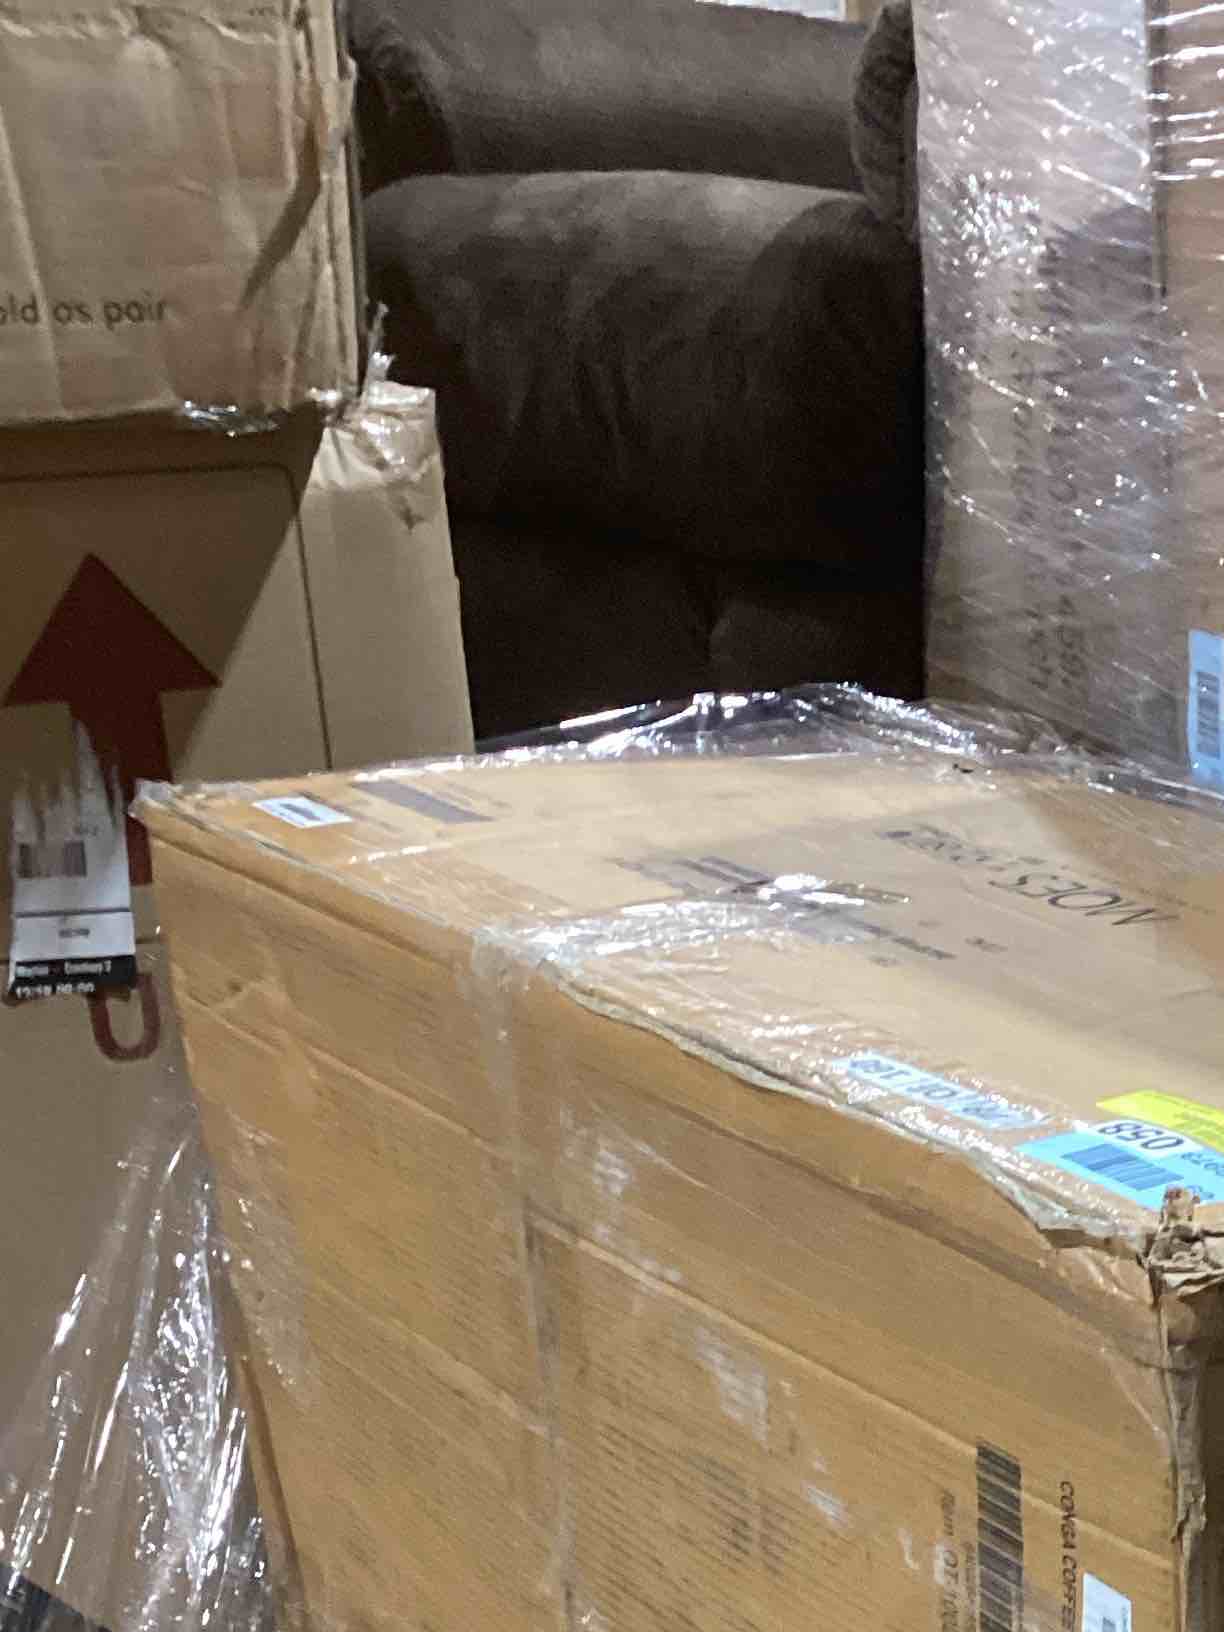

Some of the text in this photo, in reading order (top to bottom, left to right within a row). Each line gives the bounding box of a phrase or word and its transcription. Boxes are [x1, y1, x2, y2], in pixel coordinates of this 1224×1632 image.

[54, 302, 94, 325] as
[104, 289, 166, 331] pair
[1098, 1121, 1165, 1151] 058
